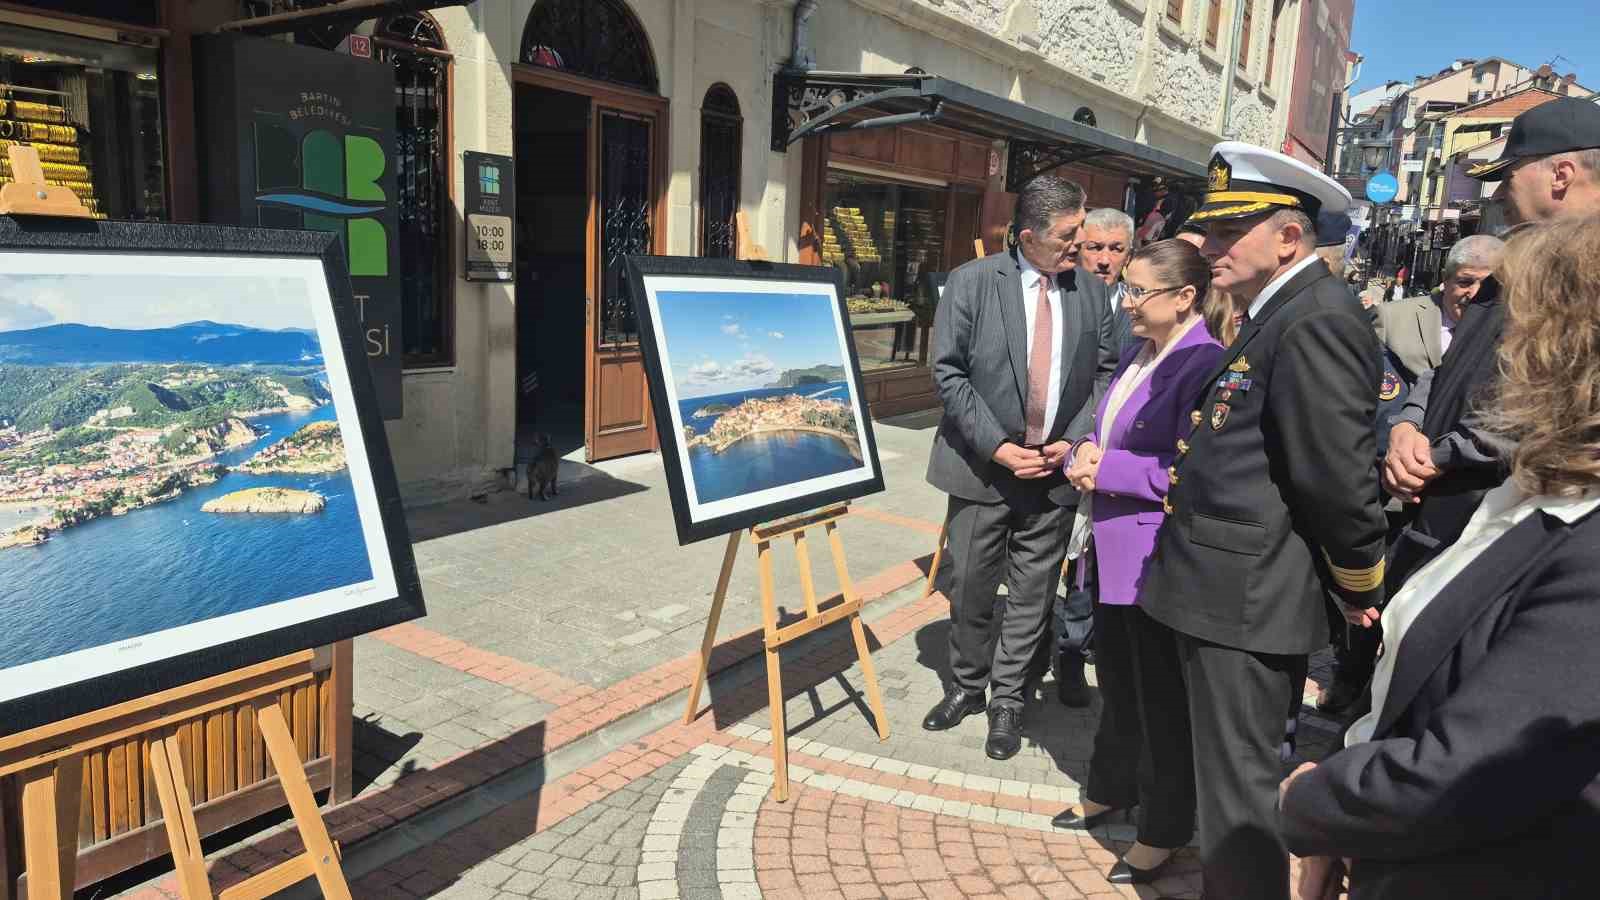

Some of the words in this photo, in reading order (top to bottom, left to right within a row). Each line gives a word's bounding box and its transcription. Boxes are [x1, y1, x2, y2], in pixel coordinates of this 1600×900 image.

[354, 39, 367, 51] 12
[476, 226, 504, 237] 10:00
[476, 239, 504, 250] 18:00
[353, 295, 370, 322] T
[366, 324, 389, 356] Sİ
